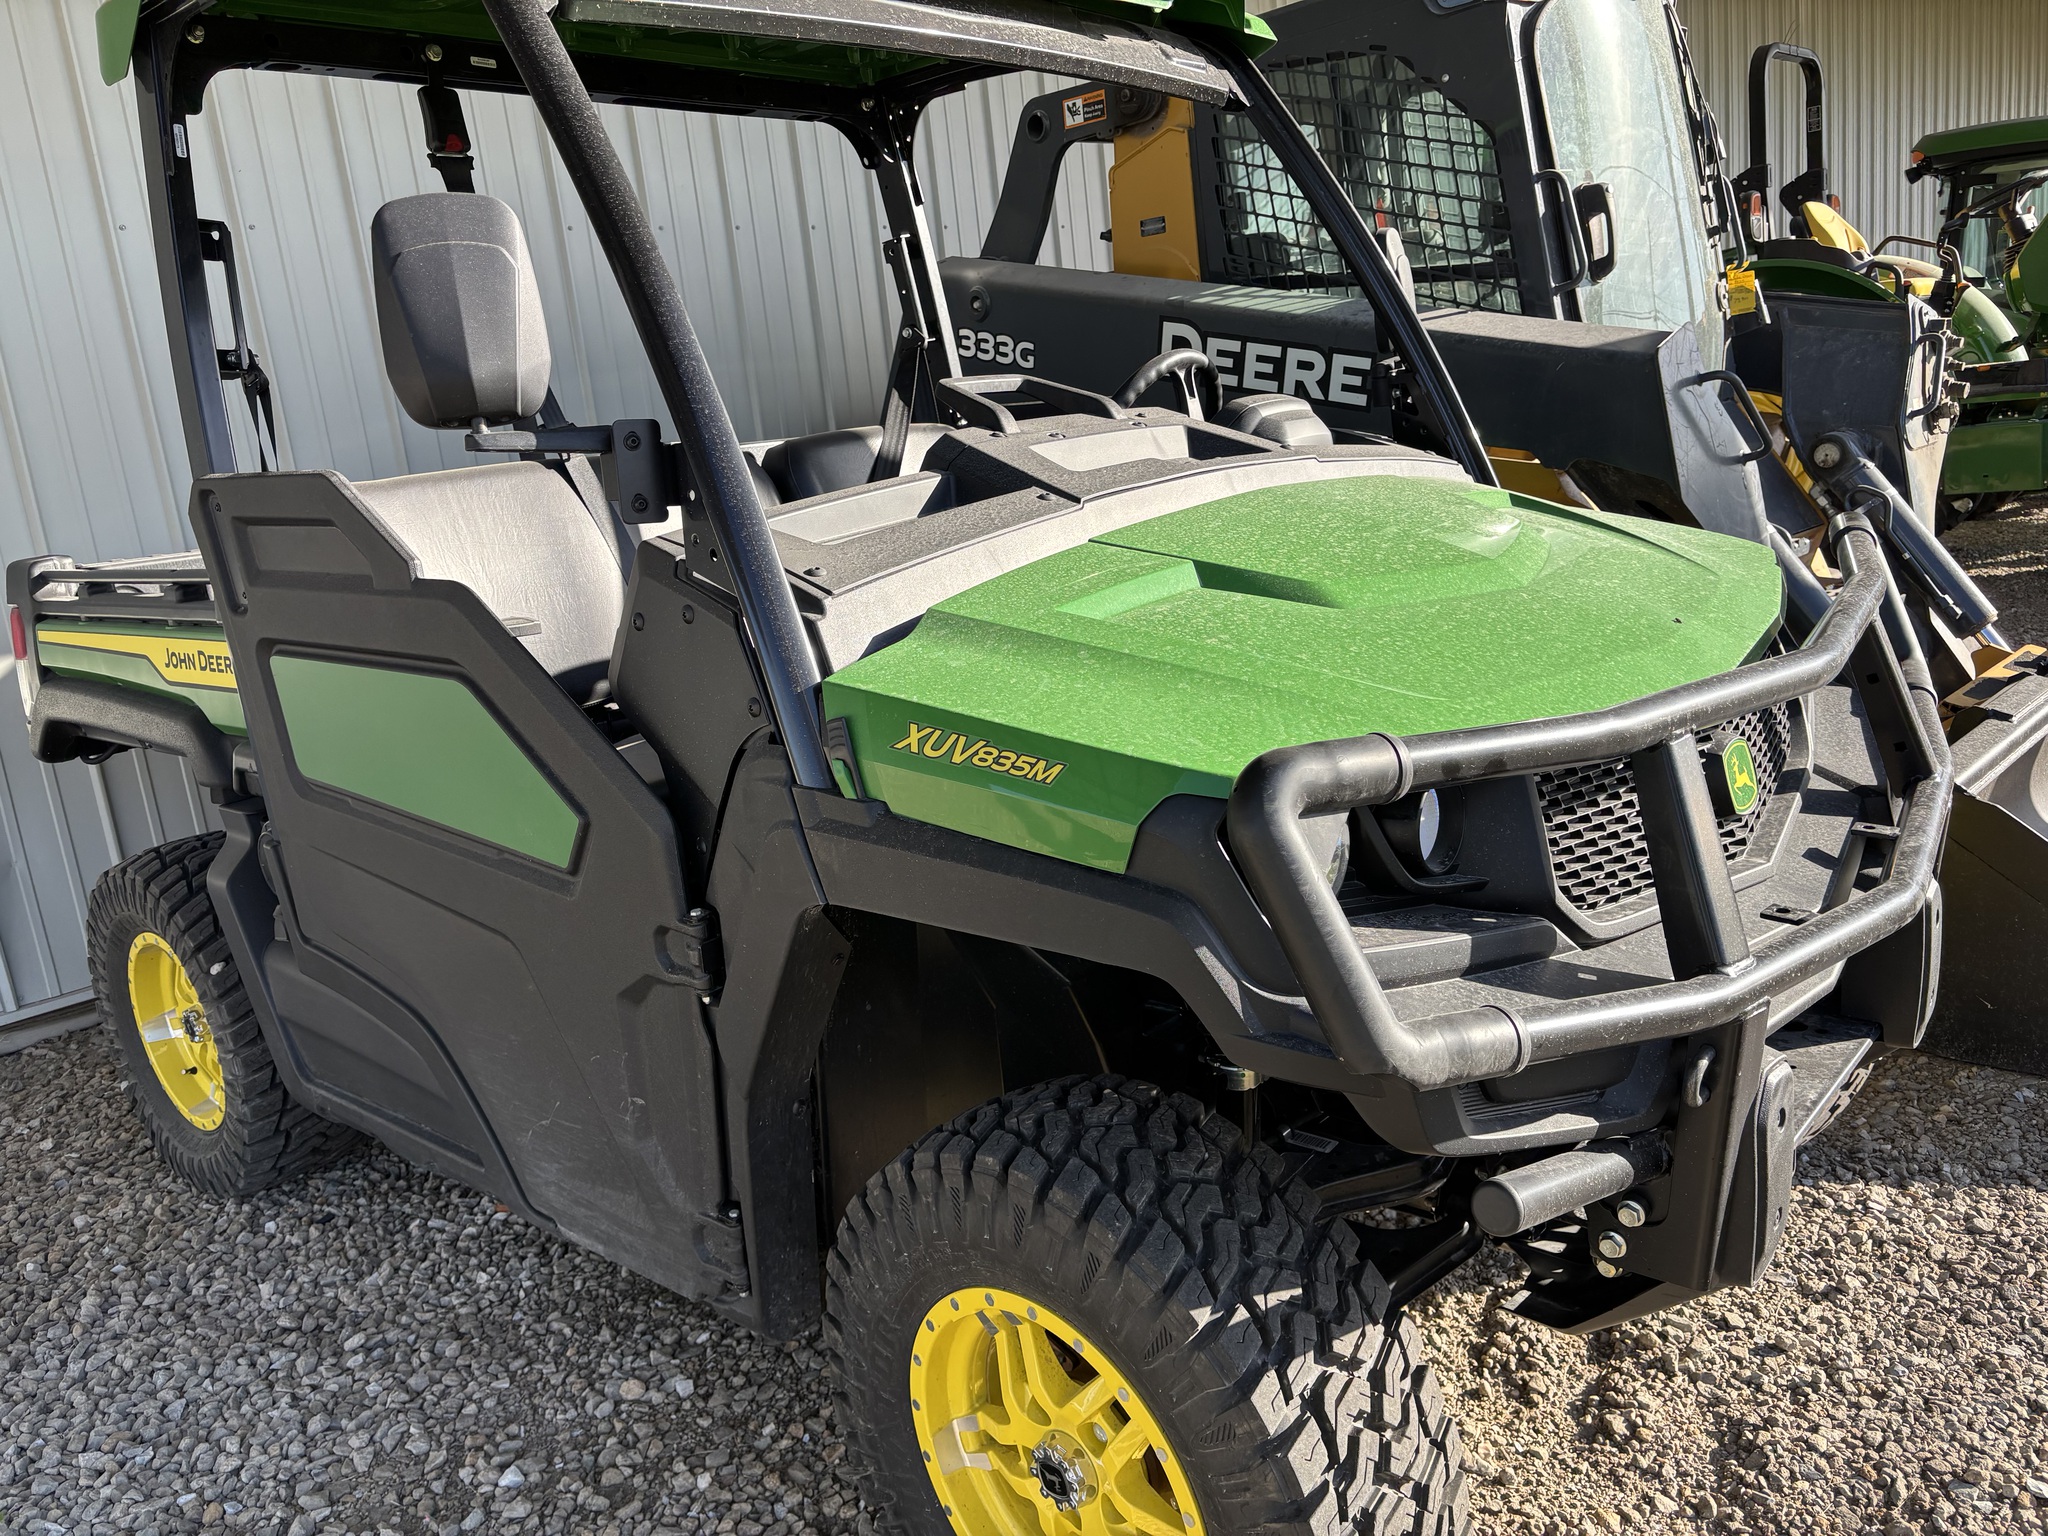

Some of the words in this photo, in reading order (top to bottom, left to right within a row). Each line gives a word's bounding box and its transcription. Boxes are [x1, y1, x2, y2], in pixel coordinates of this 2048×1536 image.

[958, 328, 1035, 369] 333G
[1161, 321, 1372, 407] DEERE
[164, 647, 197, 671] JOHN
[197, 650, 234, 674] DEER
[890, 721, 1067, 786] XUV835M
